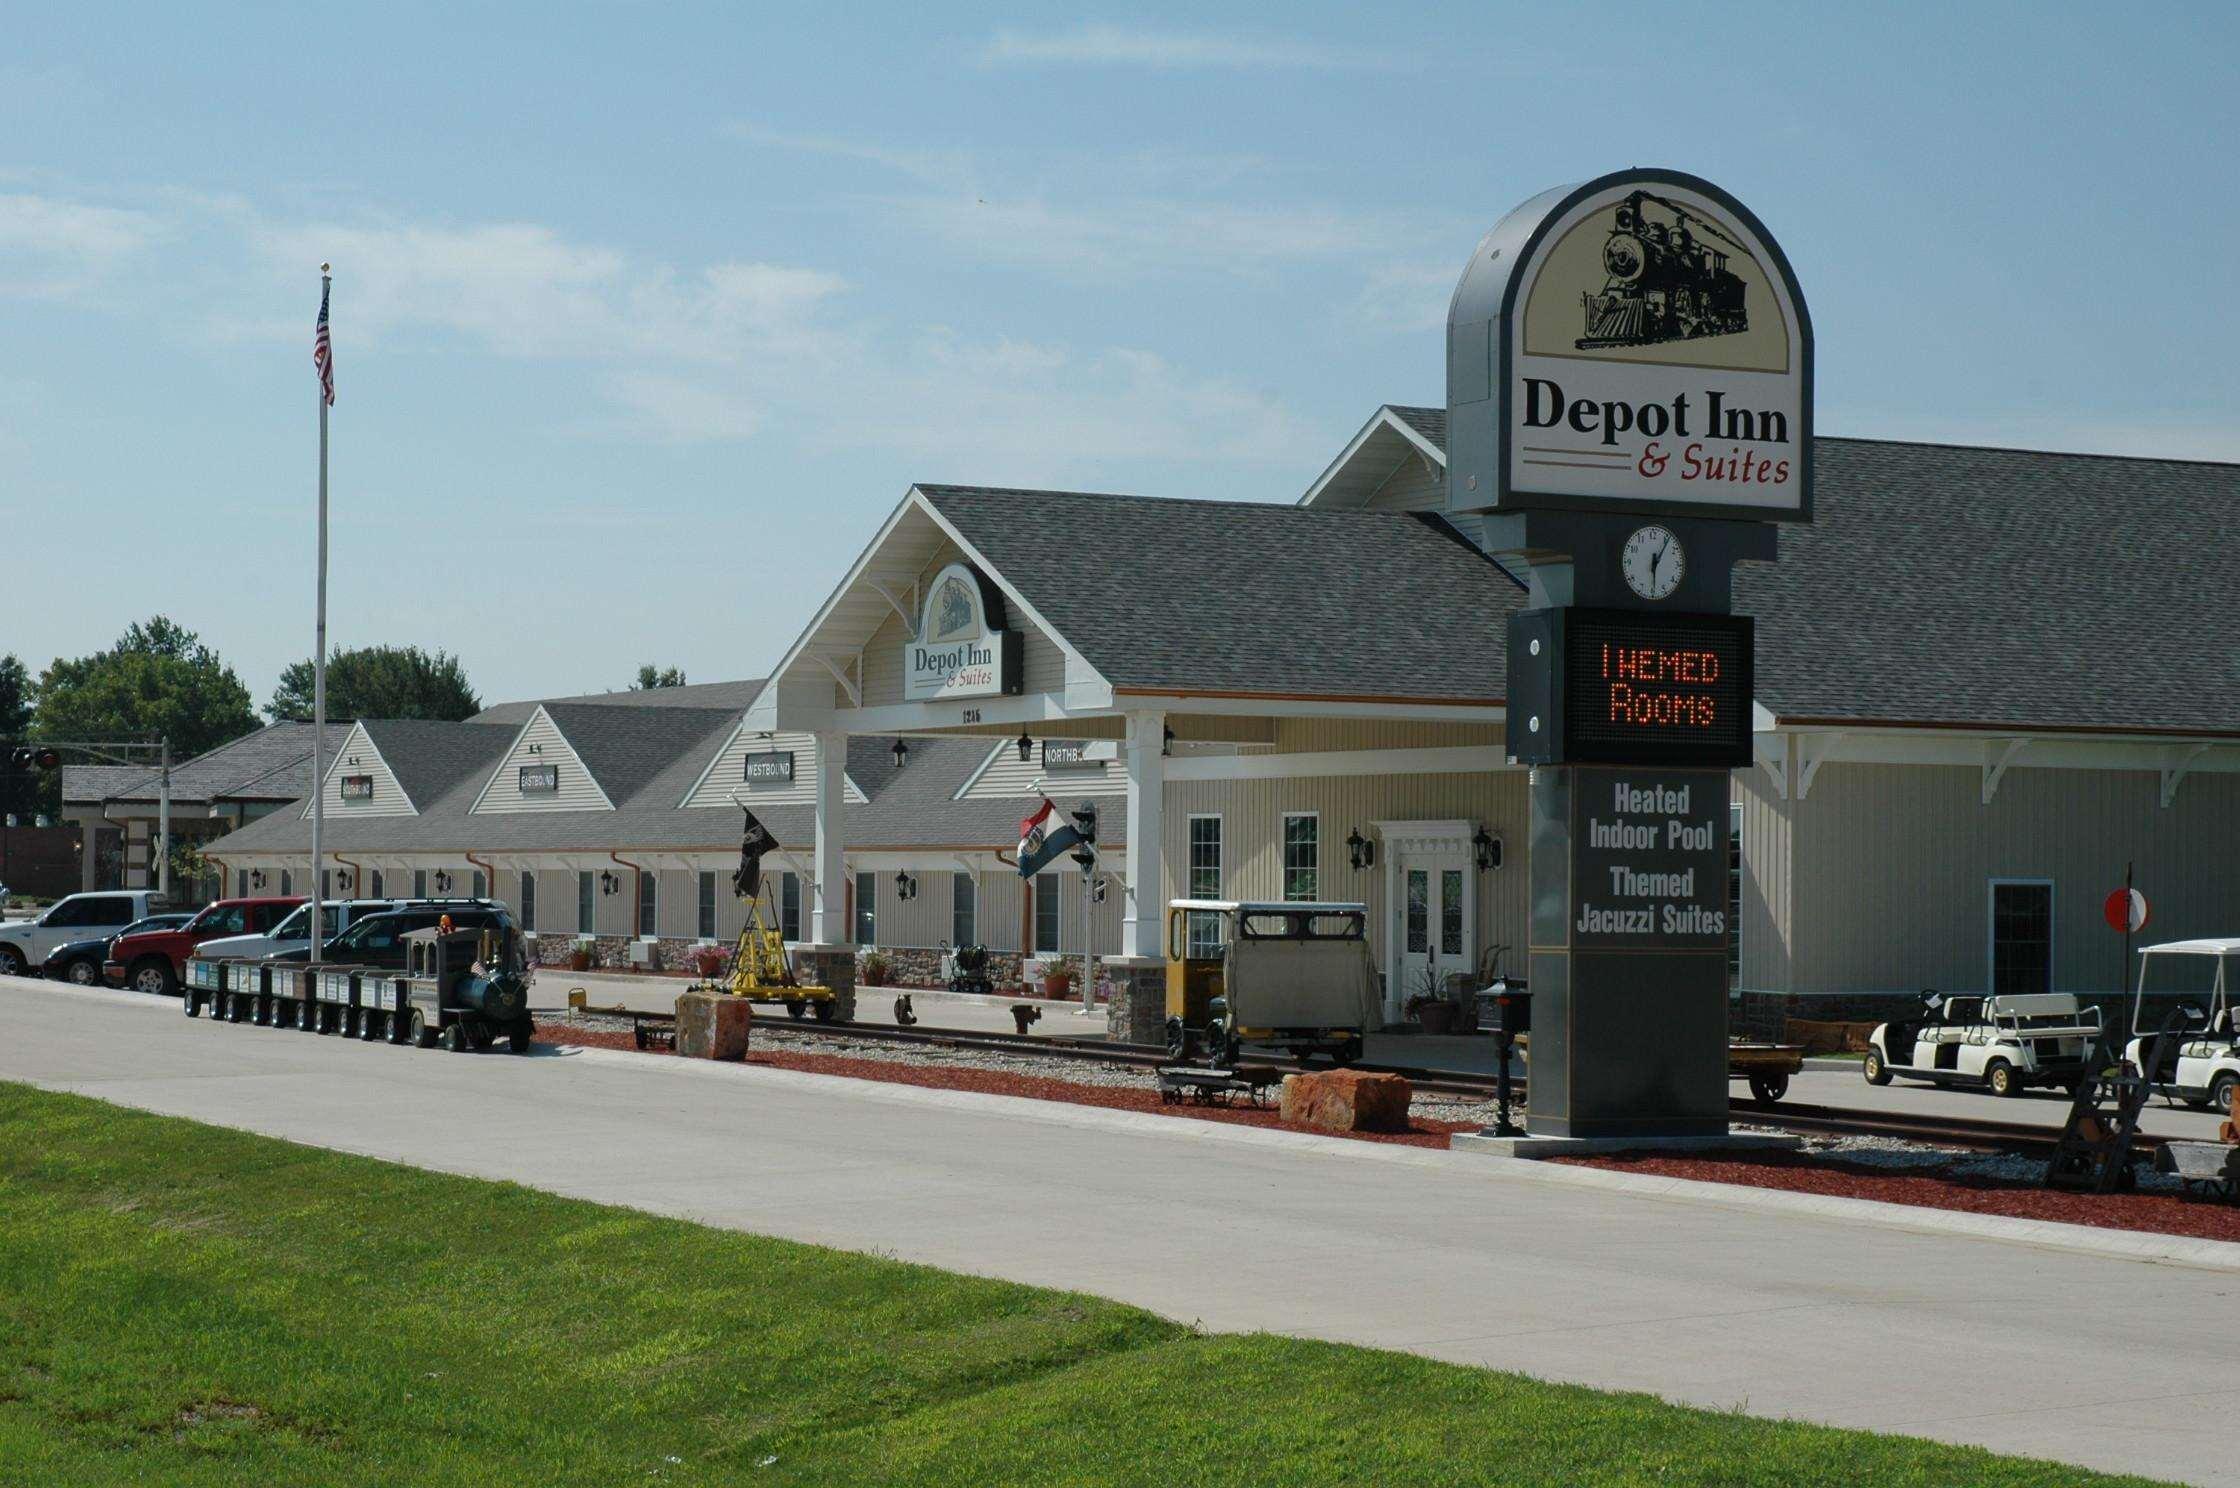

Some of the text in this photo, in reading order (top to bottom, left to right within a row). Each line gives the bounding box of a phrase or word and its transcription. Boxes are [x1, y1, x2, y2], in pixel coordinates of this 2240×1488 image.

[1522, 377, 1790, 445] Depot Inn
[1638, 442, 1790, 485] & Suites
[914, 643, 992, 675] Depot Inn
[946, 668, 993, 688] & Suites
[747, 762, 790, 776] WESTBOUND
[1614, 783, 1690, 815] Heated
[1590, 818, 1713, 850] Indoor Pool
[1609, 865, 1695, 898] Themed
[1576, 903, 1725, 935] Jacuzzi Suites
